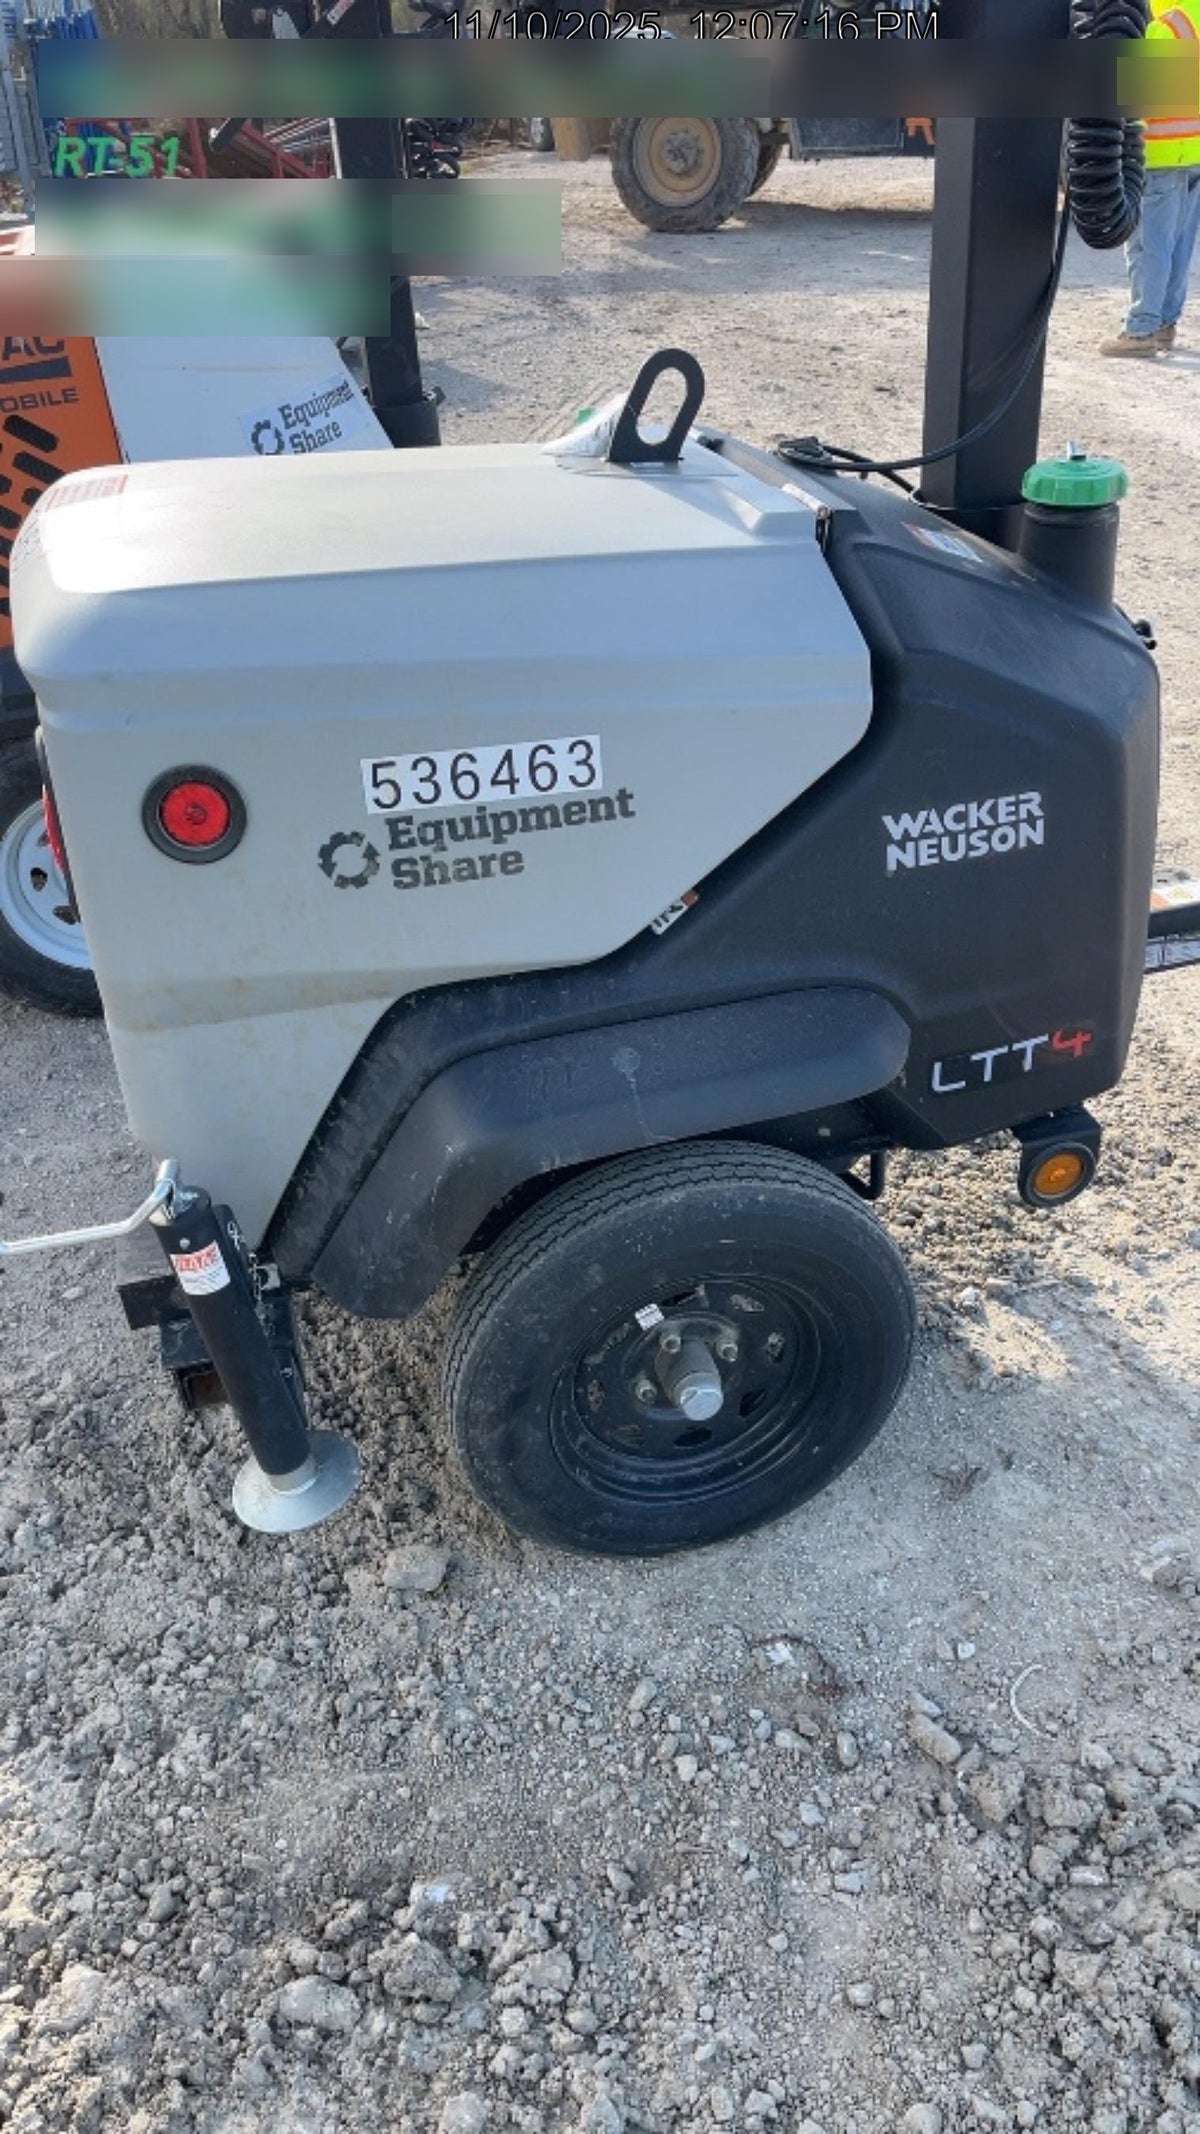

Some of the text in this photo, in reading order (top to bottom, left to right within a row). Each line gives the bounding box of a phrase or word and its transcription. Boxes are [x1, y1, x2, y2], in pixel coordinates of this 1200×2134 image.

[288, 421, 342, 455] Share
[370, 738, 597, 810] 536463
[384, 787, 636, 852] Equipment
[881, 791, 1045, 841] WACKER
[390, 850, 526, 890] Share
[886, 818, 1045, 873] NEUSON
